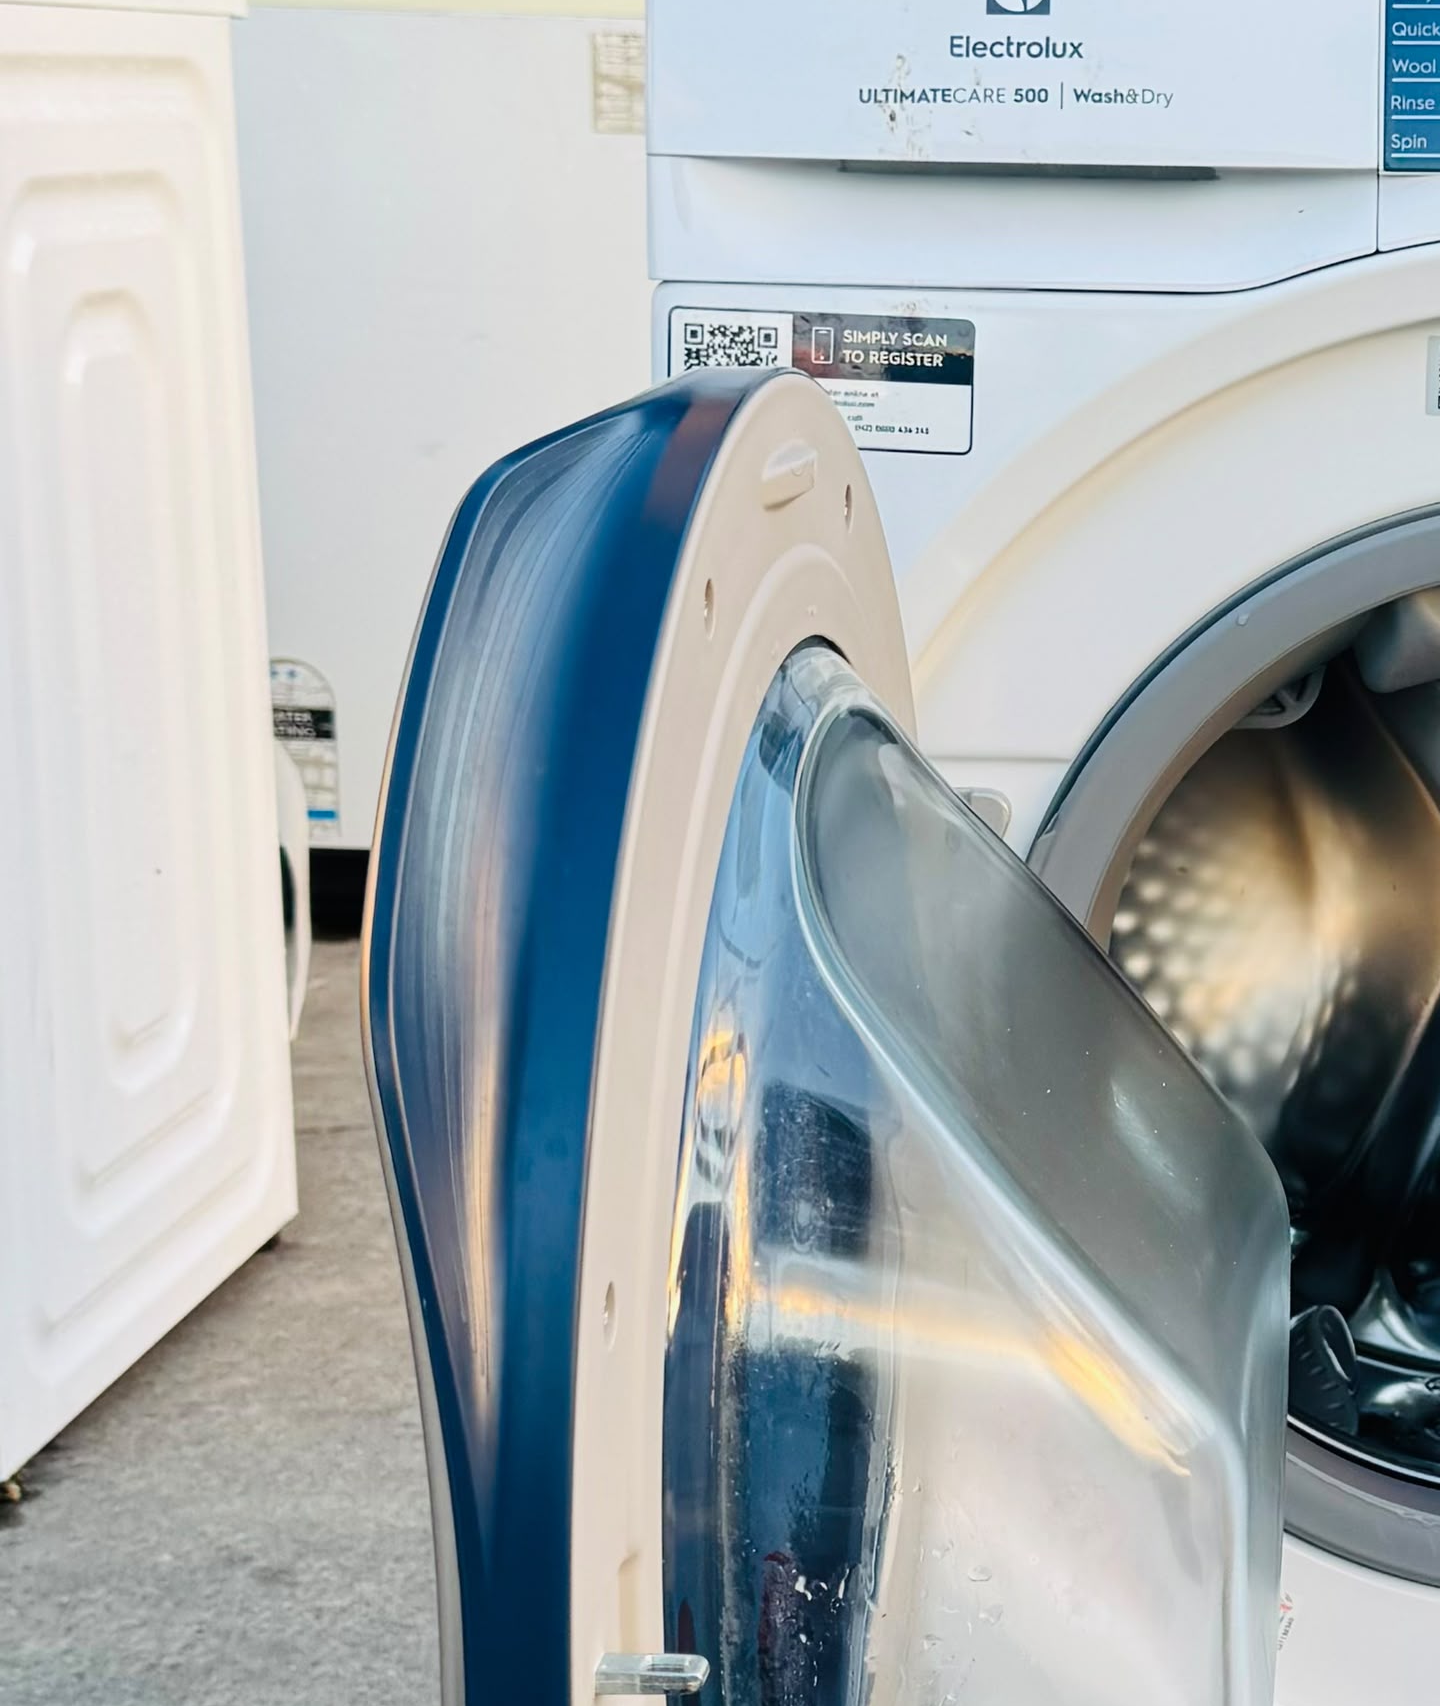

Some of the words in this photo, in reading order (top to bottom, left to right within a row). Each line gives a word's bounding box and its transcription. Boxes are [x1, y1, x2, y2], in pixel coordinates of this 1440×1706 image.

[1392, 21, 1440, 38] Quick
[950, 35, 1085, 60] Electrolux
[1392, 59, 1437, 74] Wool
[858, 87, 1006, 104] ULTIMATECARE
[1013, 87, 1049, 104] 500
[1073, 87, 1174, 109] Wash&Dry
[1391, 95, 1439, 111] Rinse
[1391, 134, 1428, 152] Spin
[843, 329, 898, 346] SIMPLY
[903, 332, 948, 348] SCAN
[842, 350, 866, 363] TO
[869, 350, 944, 367] REGISTER
[275, 711, 312, 722] ATER
